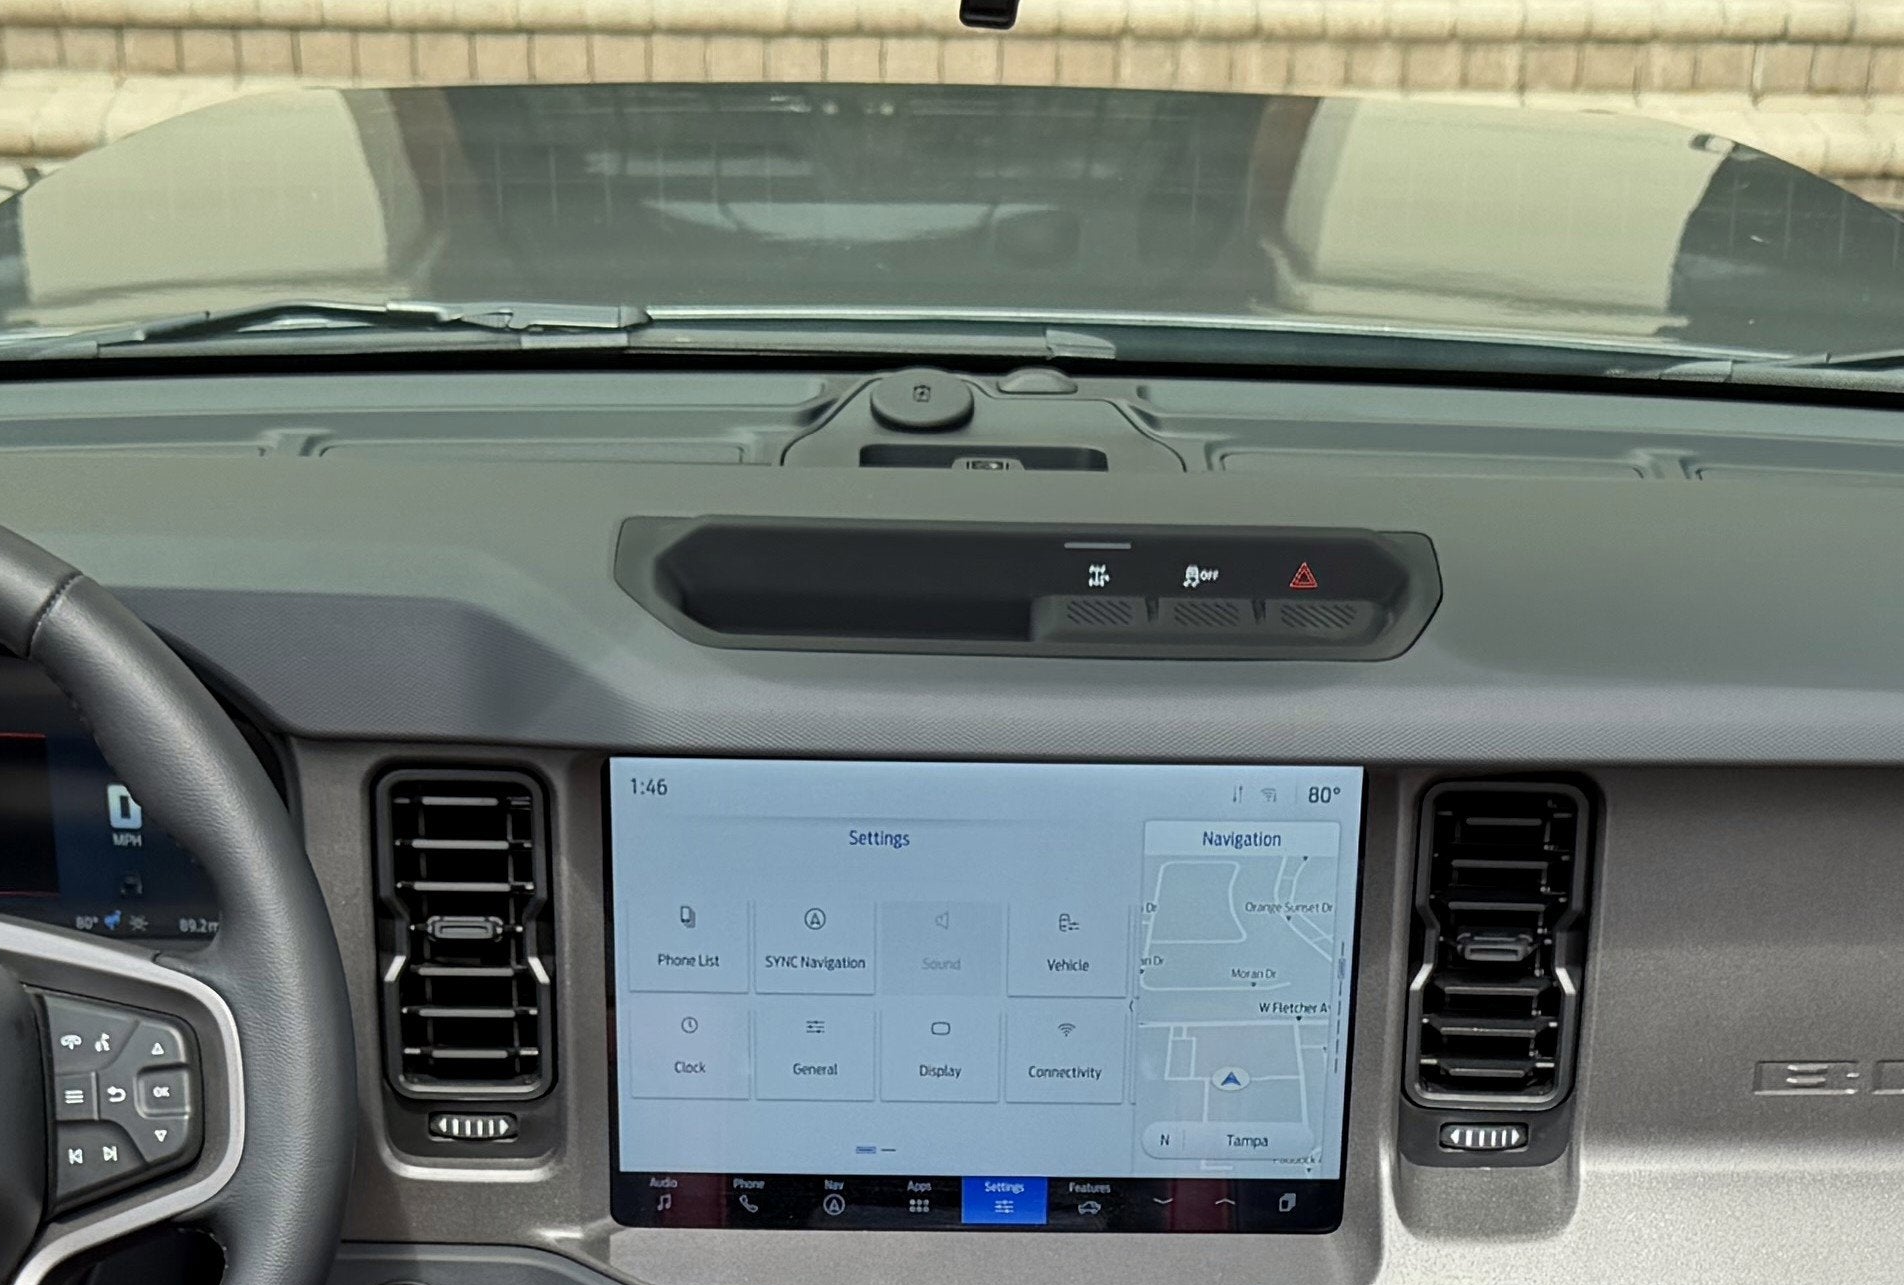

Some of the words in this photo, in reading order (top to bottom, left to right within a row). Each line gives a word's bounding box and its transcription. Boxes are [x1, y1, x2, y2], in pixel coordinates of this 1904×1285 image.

[630, 778, 668, 797] 1:46
[1308, 786, 1341, 804] 80°
[112, 834, 142, 847] MPH
[849, 830, 910, 849] Settings
[1202, 831, 1282, 849] Navigation
[1245, 903, 1282, 915] Orange
[1284, 902, 1319, 914] Sunset
[1321, 902, 1334, 913] Dr
[657, 953, 696, 968] Phone
[698, 953, 720, 969] List
[765, 955, 798, 970] SYNC
[800, 956, 866, 971] Navigation
[921, 957, 961, 971] Sound
[1046, 957, 1090, 973] Vehicle
[1231, 968, 1264, 979] Moran
[1265, 969, 1277, 979] Dr
[1259, 1002, 1270, 1013] W
[1272, 1002, 1317, 1013] Fletcher
[674, 1060, 706, 1075] Clock
[792, 1062, 838, 1077] General
[919, 1064, 962, 1081] Display
[1028, 1064, 1102, 1081] Connectivity
[153, 1086, 170, 1098] OK
[1160, 1134, 1170, 1146] N
[1227, 1134, 1269, 1148] Tampa
[649, 1177, 678, 1190] Audio
[733, 1179, 765, 1191] Phone
[824, 1180, 844, 1191] Nav
[907, 1181, 932, 1194] Apps
[984, 1181, 1025, 1195] Settings
[1069, 1182, 1111, 1194] Features
